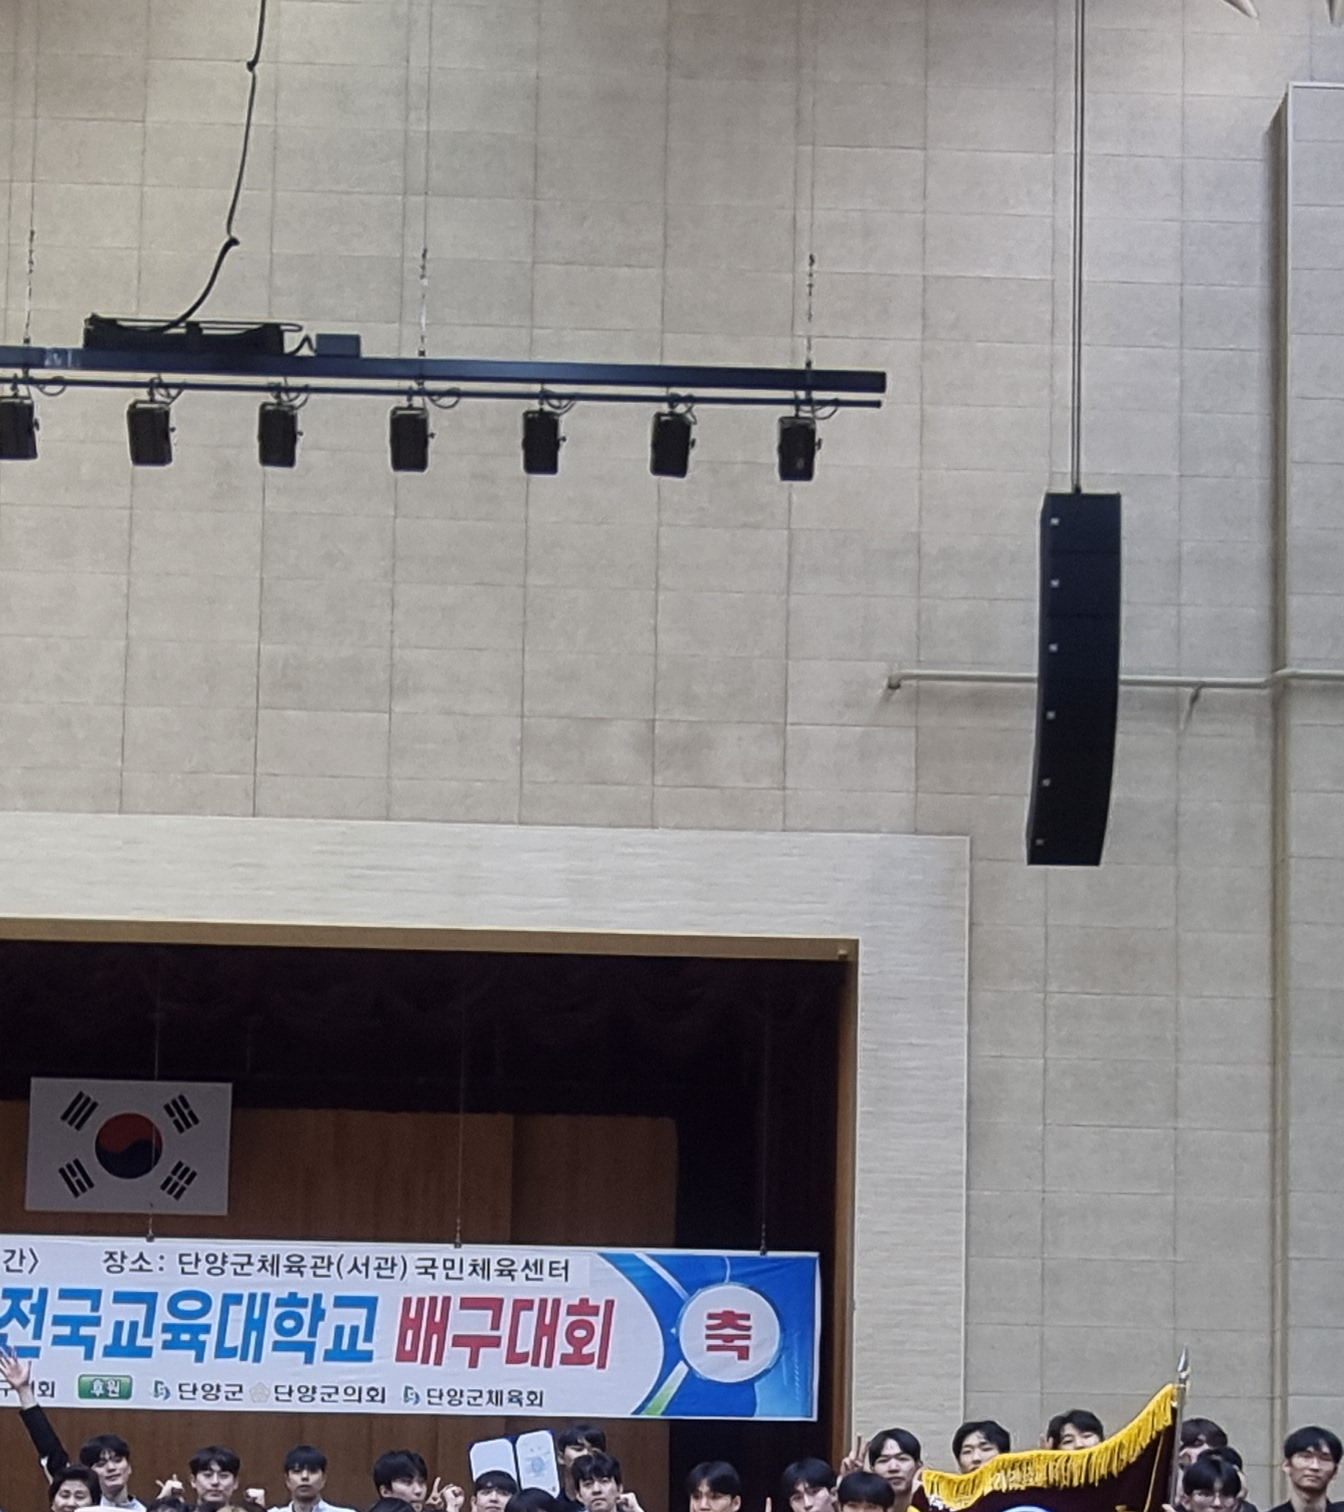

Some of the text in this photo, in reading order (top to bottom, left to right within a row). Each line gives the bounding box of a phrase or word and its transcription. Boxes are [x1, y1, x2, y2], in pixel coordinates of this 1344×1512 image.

[102, 1250, 165, 1276] 장소:
[177, 1253, 408, 1281] 단양군체육관(서관)
[414, 1256, 571, 1284] 국민체육센터
[395, 1295, 615, 1370] 배구대회
[704, 1309, 753, 1361] 축
[91, 1377, 121, 1398] 후원
[177, 1382, 244, 1403] 단양군
[273, 1383, 387, 1404] 단양군의회
[426, 1386, 545, 1408] 단양군체육회
